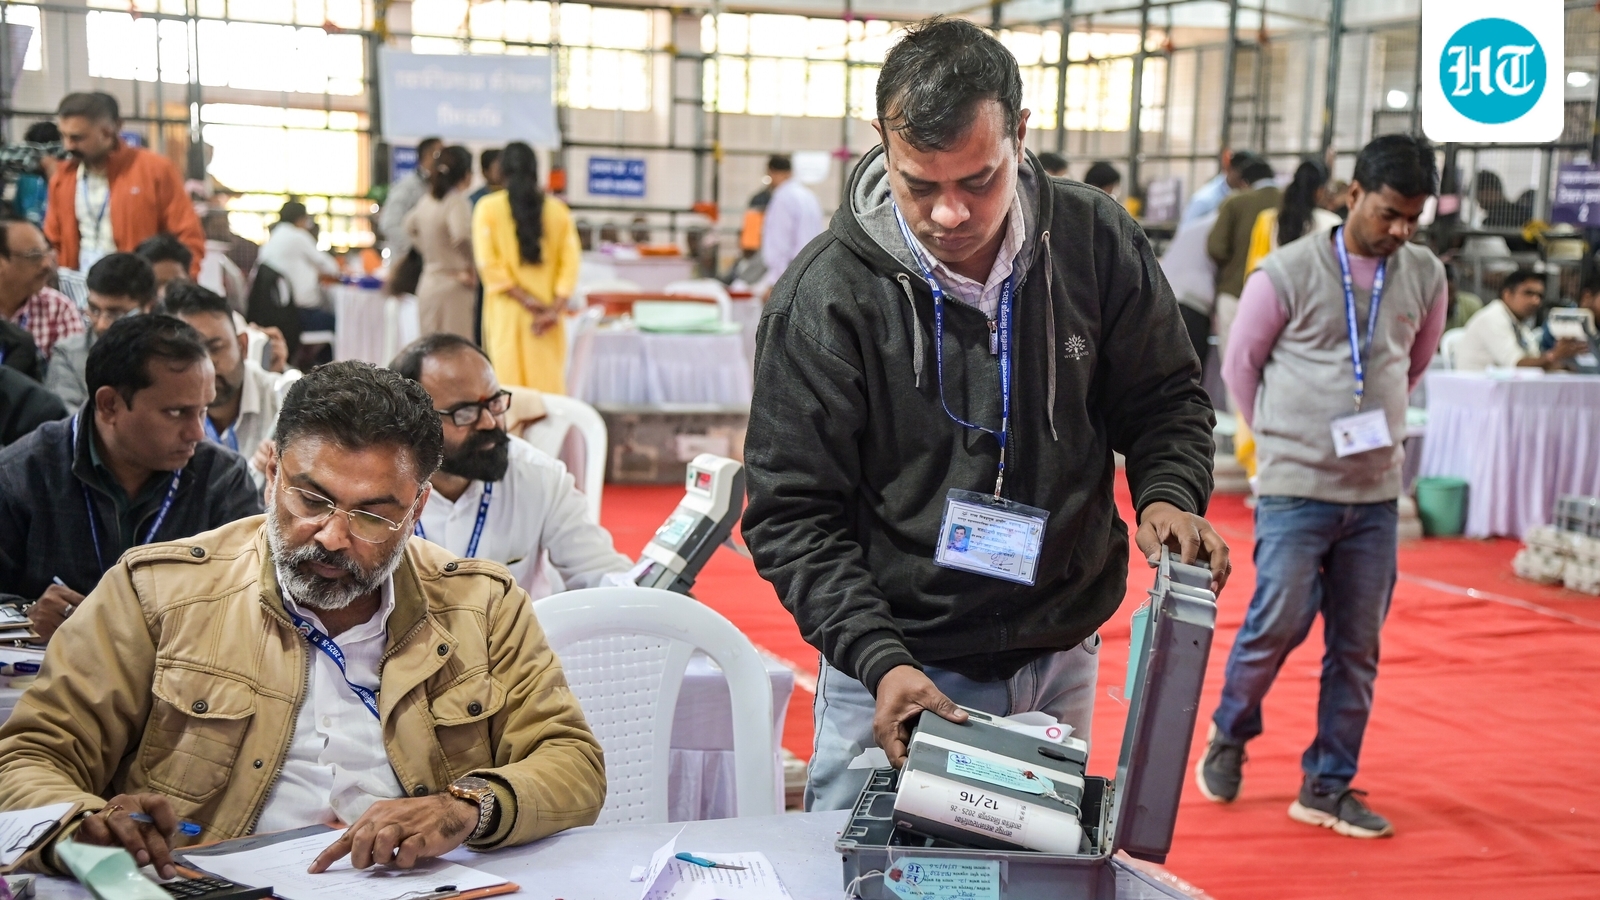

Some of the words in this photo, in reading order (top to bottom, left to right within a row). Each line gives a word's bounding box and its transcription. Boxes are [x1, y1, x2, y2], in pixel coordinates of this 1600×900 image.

[1001, 281, 1011, 304] 2025-26
[959, 791, 999, 810] 12/16
[950, 804, 958, 812] 26
[962, 808, 976, 817] 2025
